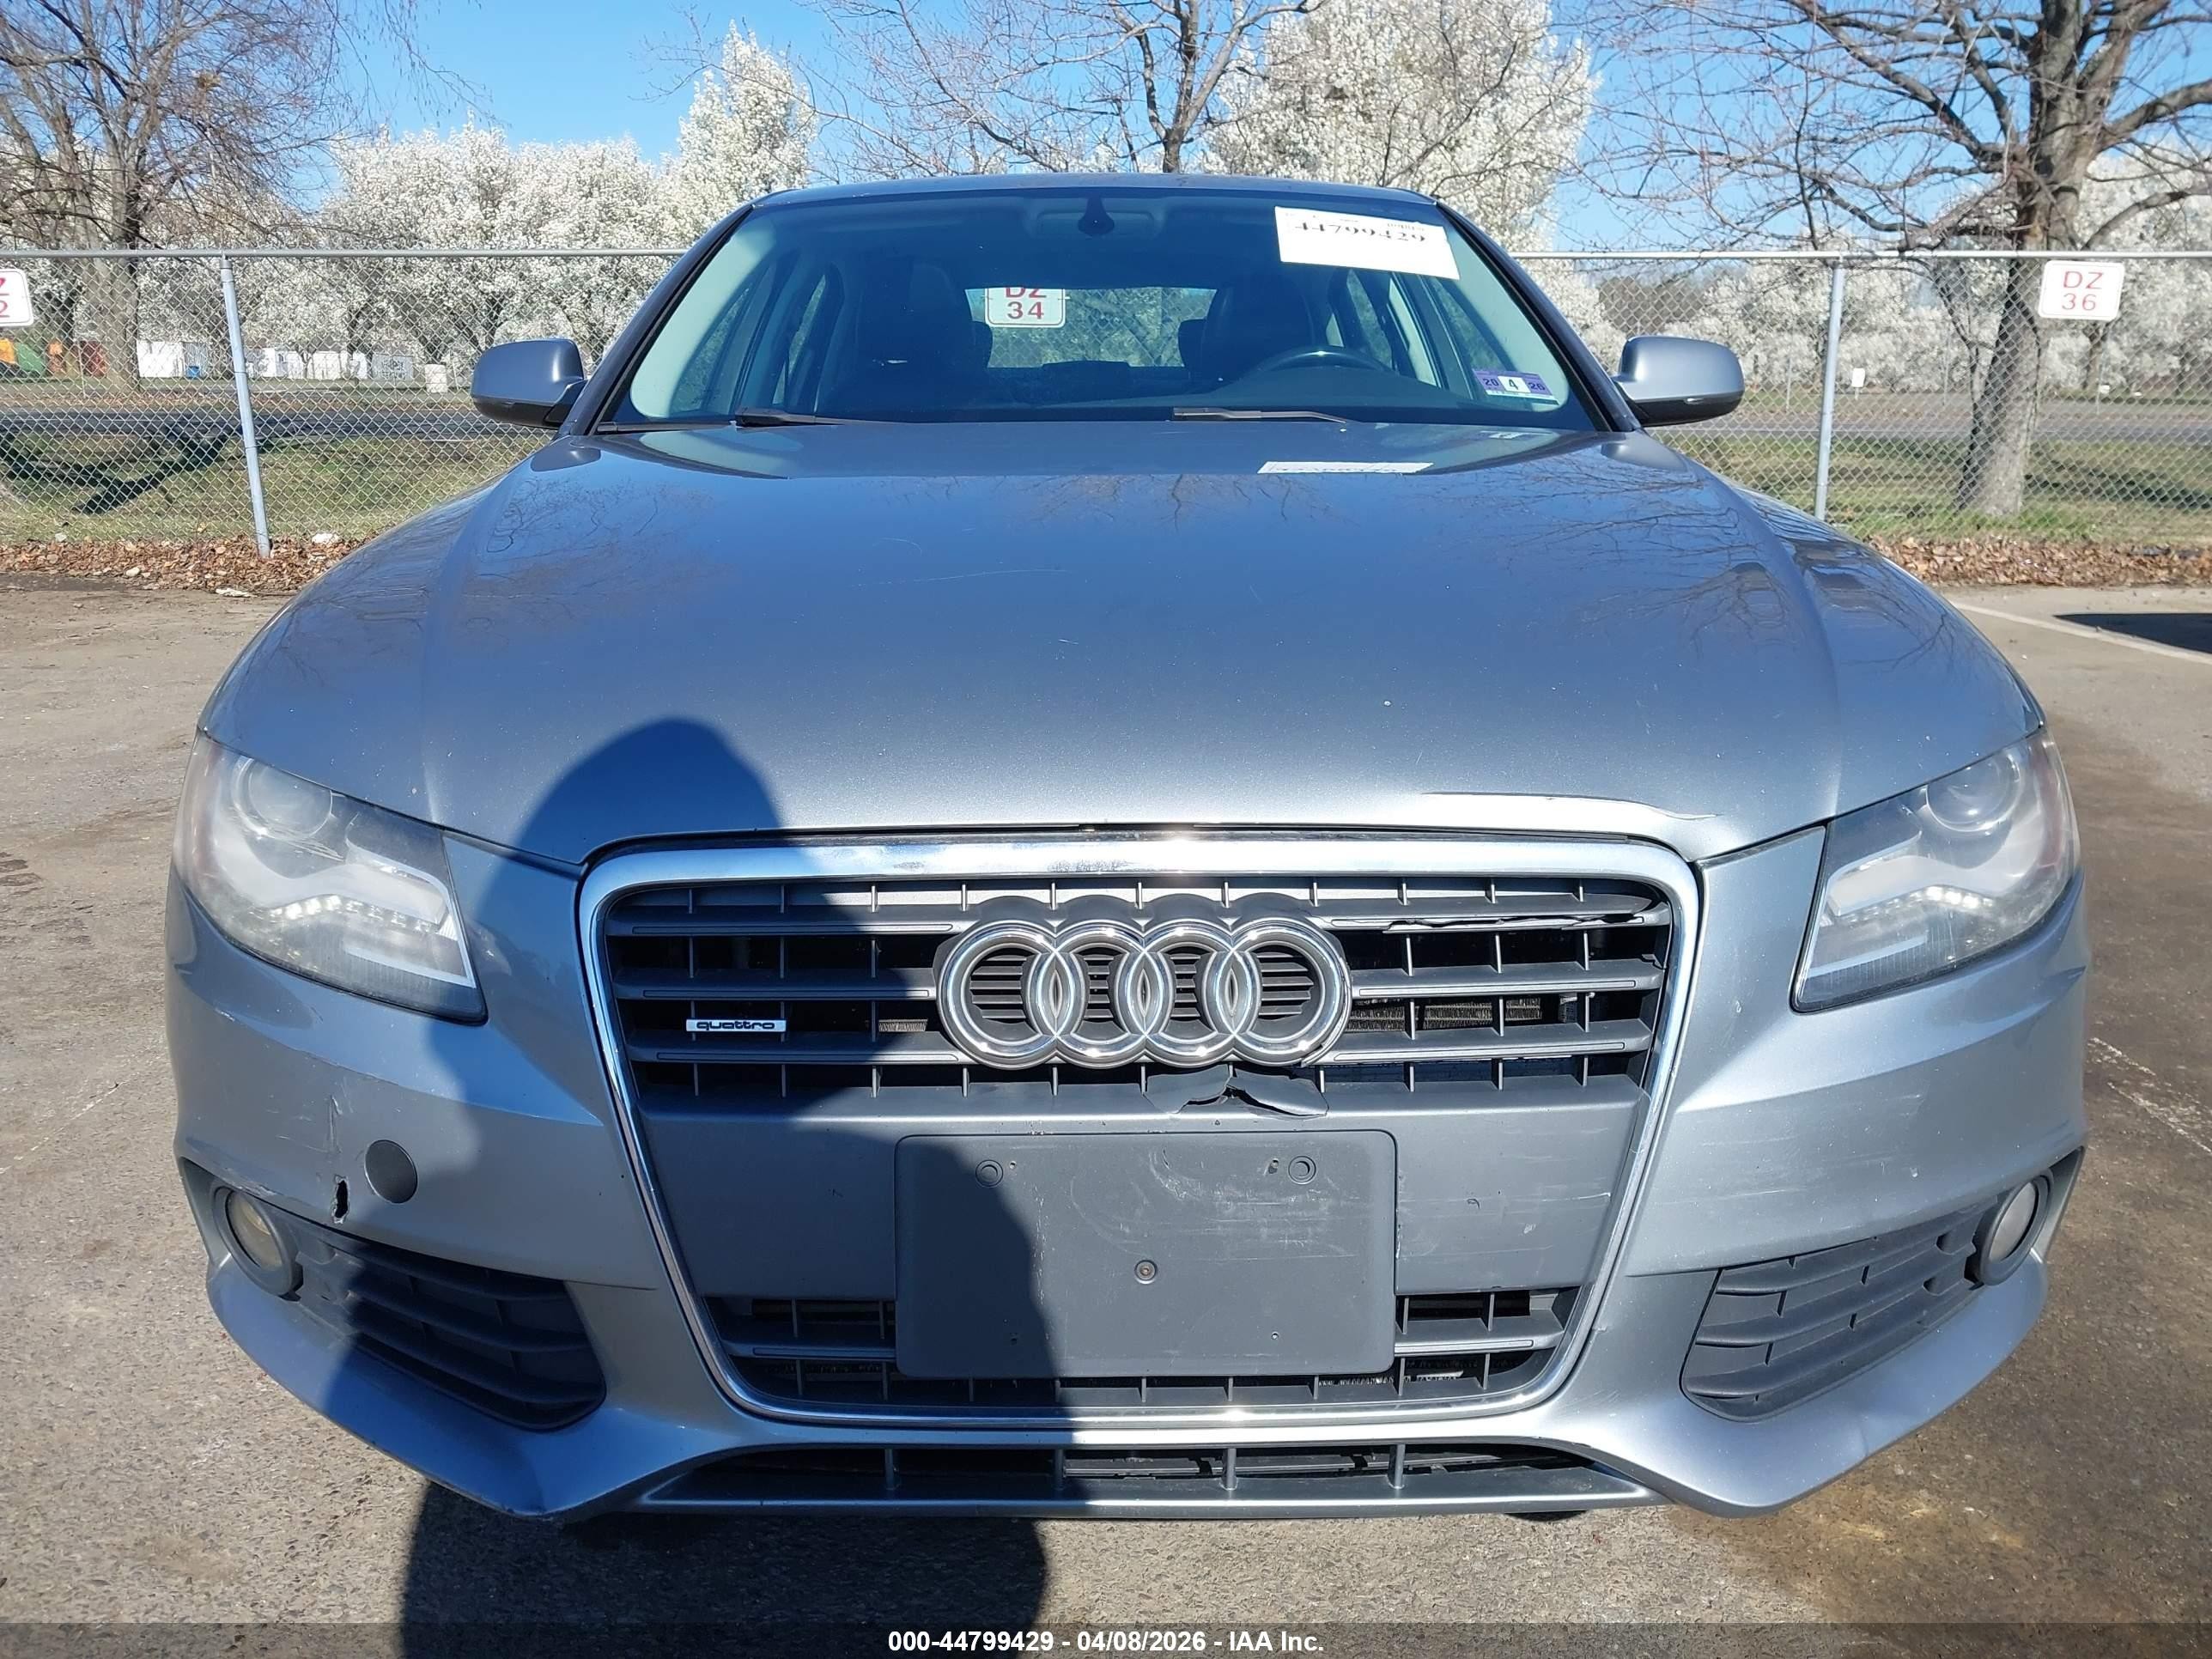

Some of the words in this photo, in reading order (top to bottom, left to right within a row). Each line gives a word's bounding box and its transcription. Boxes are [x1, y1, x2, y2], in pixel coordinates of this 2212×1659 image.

[2063, 270, 2105, 289] DZ
[1006, 301, 1044, 319] 34
[2062, 293, 2096, 311] 36
[1482, 378, 1499, 387] 20
[1508, 379, 1519, 391] 4
[696, 1020, 775, 1031] quattro
